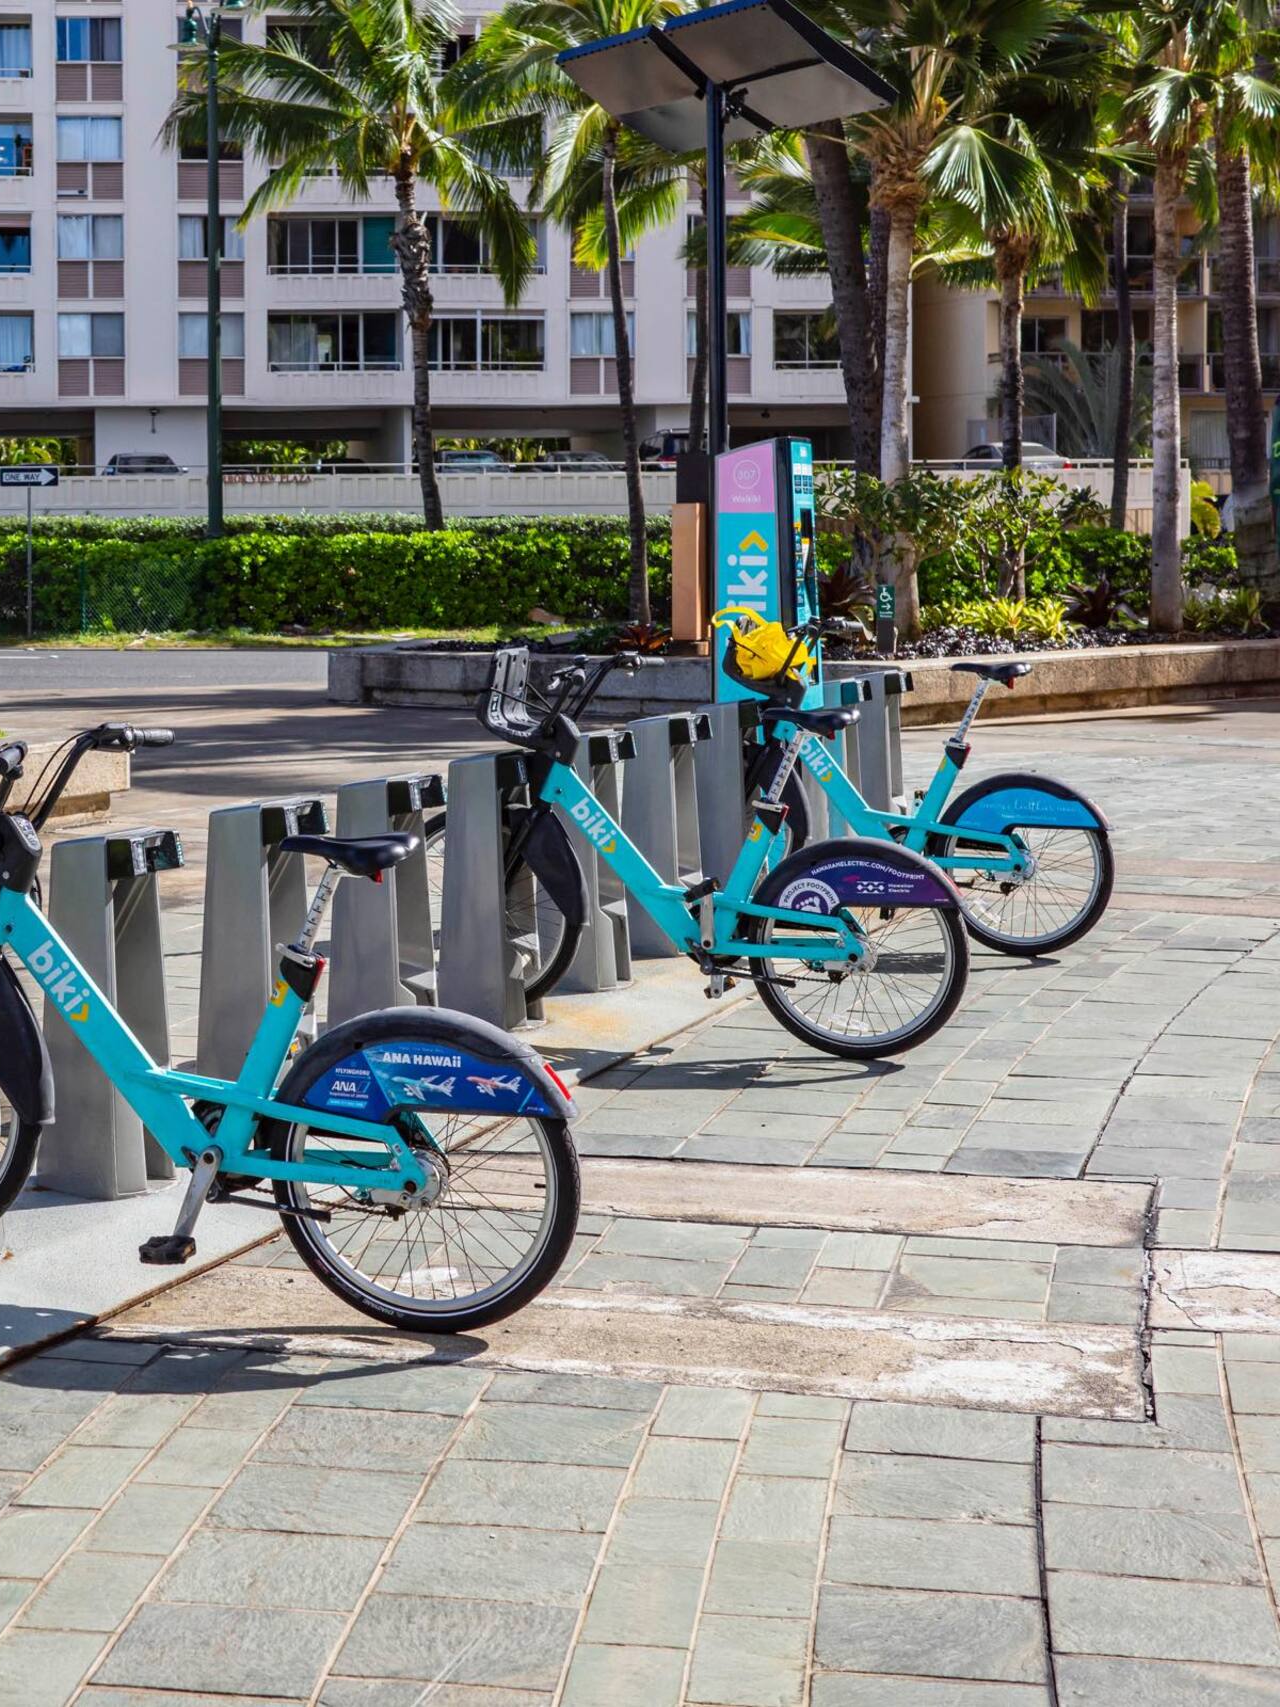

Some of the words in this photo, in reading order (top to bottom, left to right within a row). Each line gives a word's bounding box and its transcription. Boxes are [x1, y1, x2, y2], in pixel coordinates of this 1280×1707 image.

[4, 473, 22, 481] ONE
[23, 473, 40, 481] WAY
[726, 554, 768, 613] iki
[570, 796, 617, 847] biki
[783, 882, 806, 904] PROJECT
[806, 883, 837, 905] FOOTPRINT
[26, 939, 90, 1012] biki
[382, 1052, 411, 1065] ANA
[331, 1080, 357, 1093] ANA
